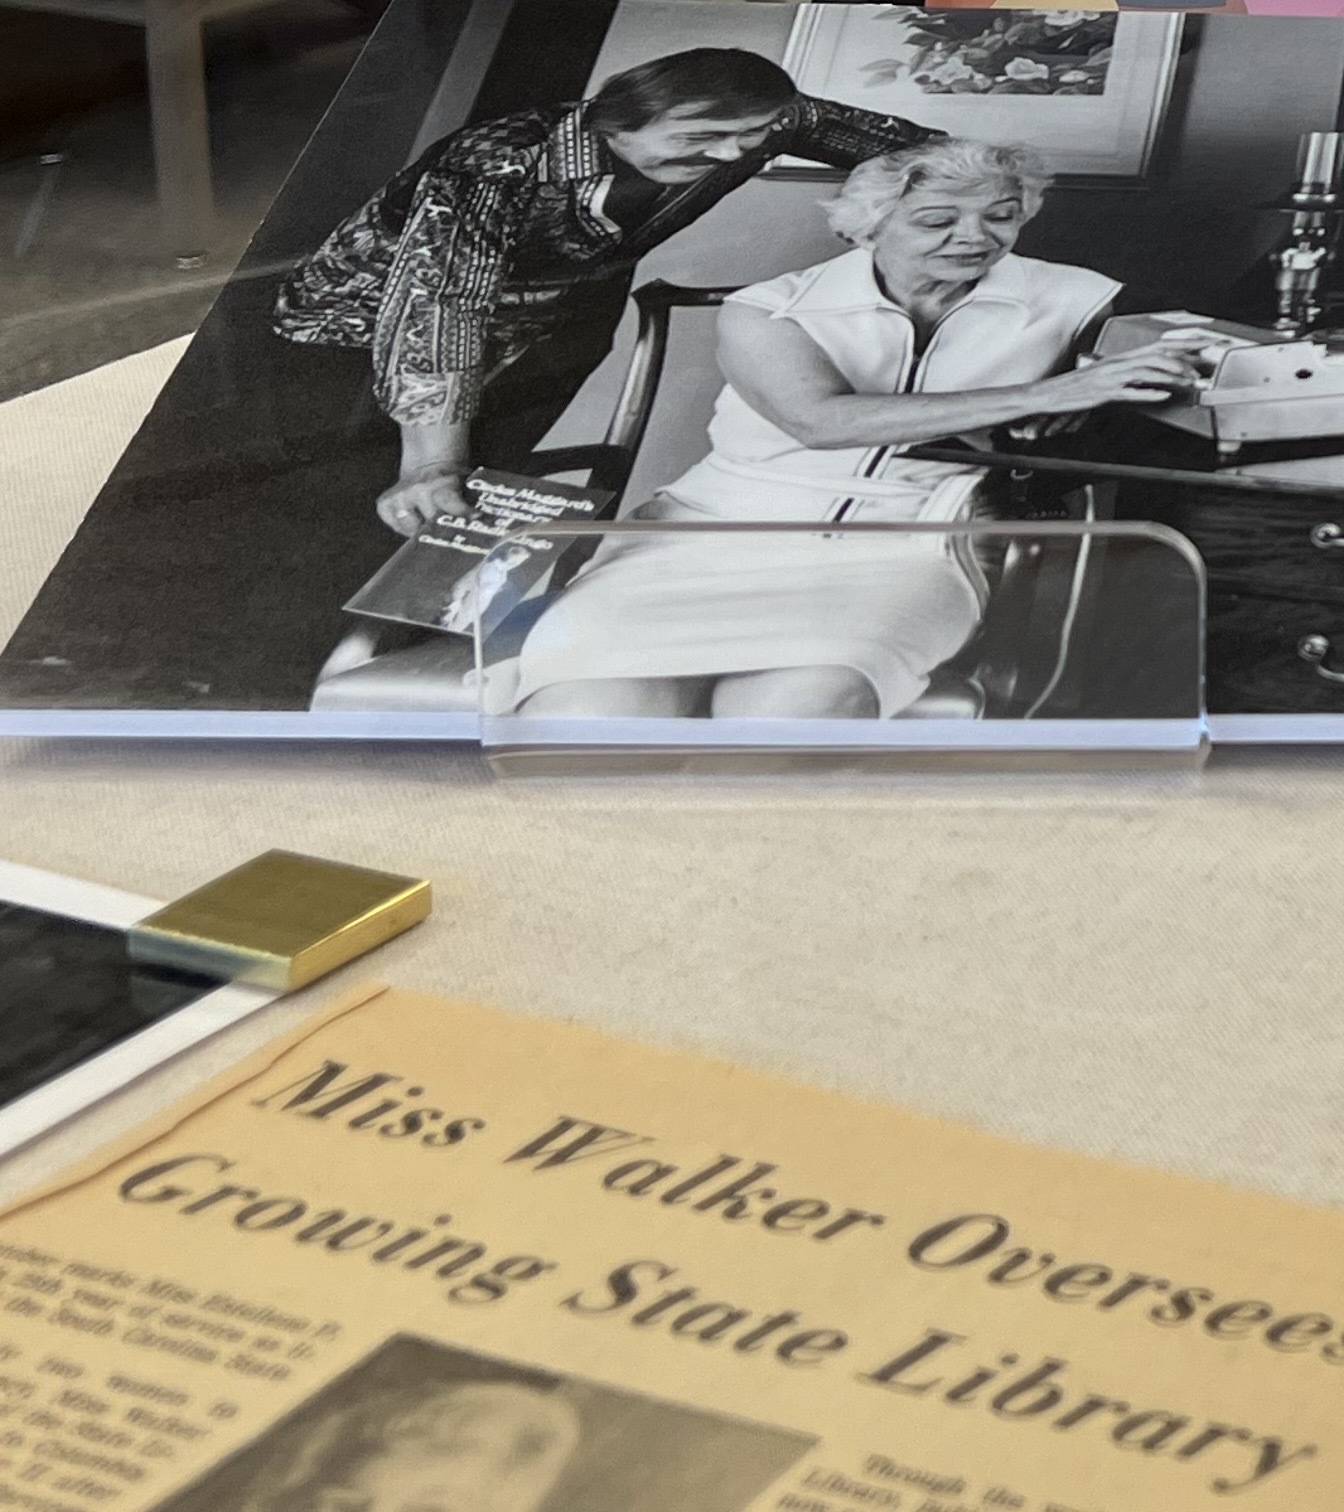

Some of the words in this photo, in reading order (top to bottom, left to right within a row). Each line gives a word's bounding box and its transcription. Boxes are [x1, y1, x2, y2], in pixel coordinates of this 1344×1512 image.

[250, 1059, 485, 1148] Miss
[503, 1116, 885, 1245] Walker
[118, 1153, 559, 1306] Growing
[561, 1258, 850, 1367] State
[856, 1327, 1319, 1495] Library
